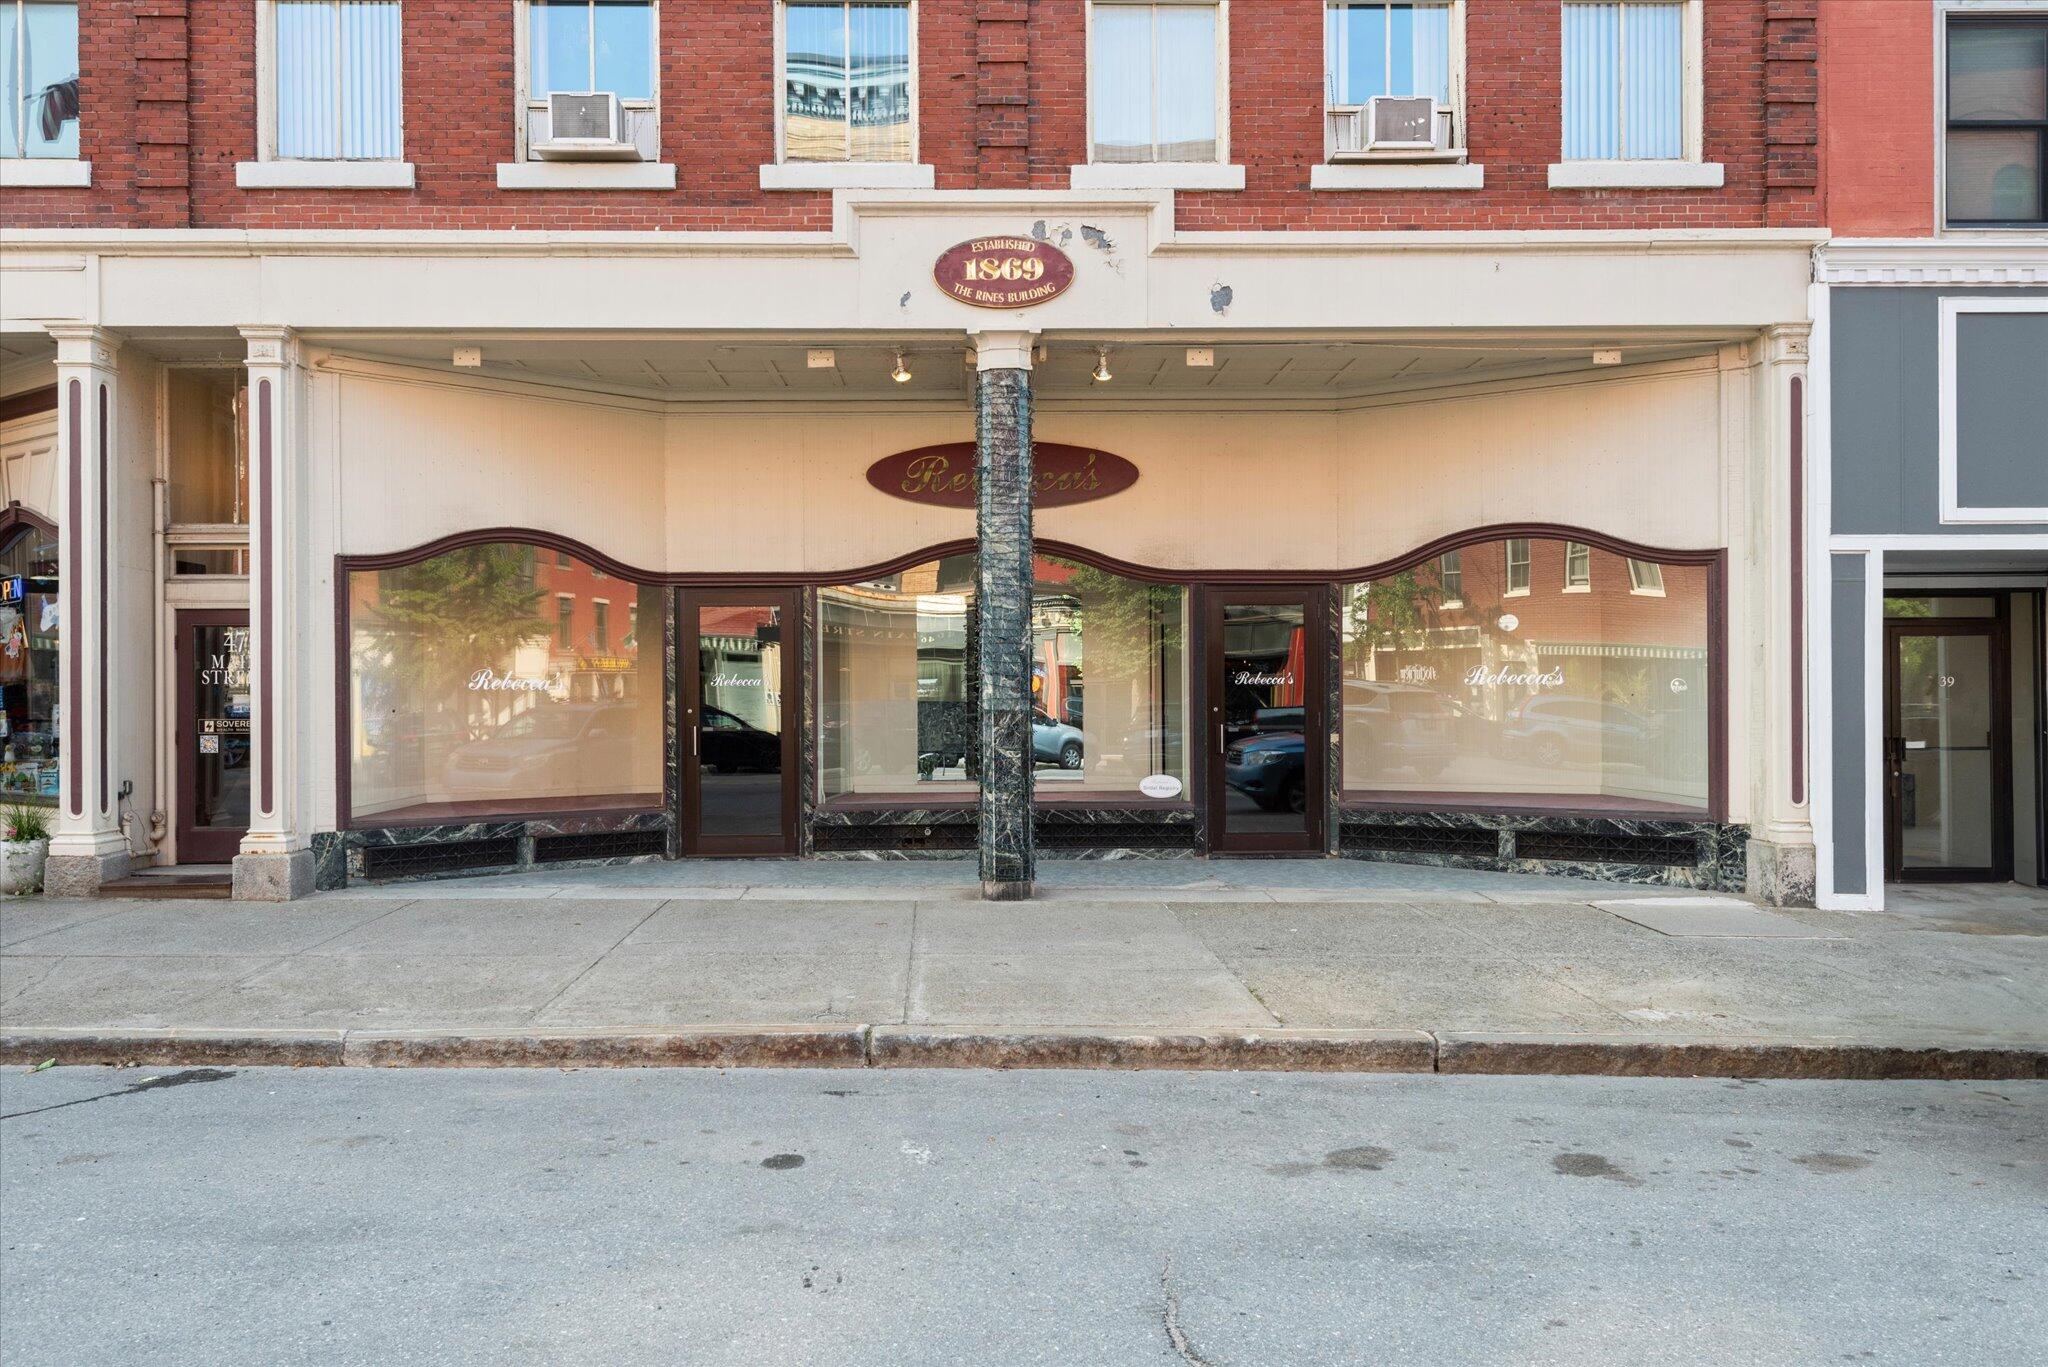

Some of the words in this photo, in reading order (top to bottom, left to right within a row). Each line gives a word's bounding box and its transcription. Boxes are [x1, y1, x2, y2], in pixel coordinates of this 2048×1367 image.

[971, 239, 1035, 253] ESTABLISHED
[963, 257, 1044, 281] 1869
[954, 282, 973, 298] THE
[975, 290, 1005, 303] RINES
[1008, 282, 1056, 303] BUILDING
[901, 453, 1101, 493] Reca's
[223, 630, 246, 653] 47
[201, 669, 250, 686] STRE
[468, 668, 564, 692] Rebecca's
[1234, 670, 1294, 685] Rebecca's
[1464, 665, 1565, 687] Rebecca's
[1939, 675, 1955, 688] 39
